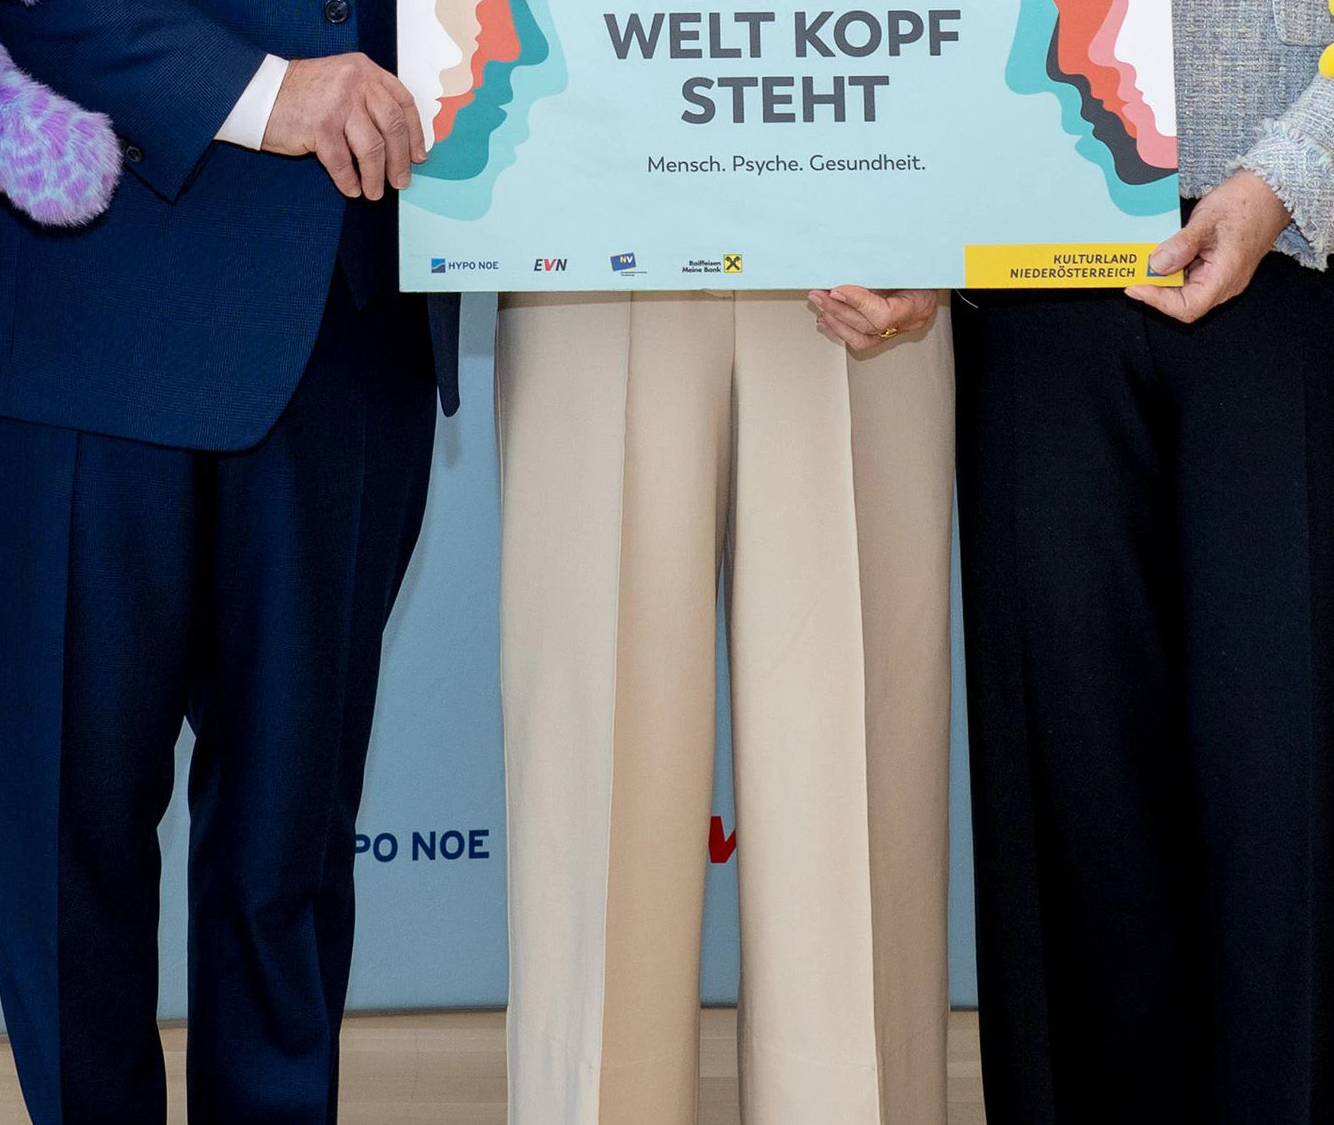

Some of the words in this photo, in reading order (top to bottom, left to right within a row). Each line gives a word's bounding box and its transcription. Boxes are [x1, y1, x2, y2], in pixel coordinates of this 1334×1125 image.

[602, 11, 776, 60] WELT
[794, 9, 962, 58] KOPF
[680, 75, 890, 125] STEHT
[648, 155, 727, 173] Mensch.
[732, 155, 804, 176] Psyche.
[809, 154, 926, 172] Gesundheit.
[448, 261, 476, 270] HYPO
[478, 261, 500, 270] NOE
[533, 258, 568, 272] EVN
[1053, 253, 1138, 265] KULTURLAND
[1010, 265, 1136, 279] NIEDERÖSTERREICH
[355, 832, 398, 863] PO
[412, 829, 490, 861] NOE
